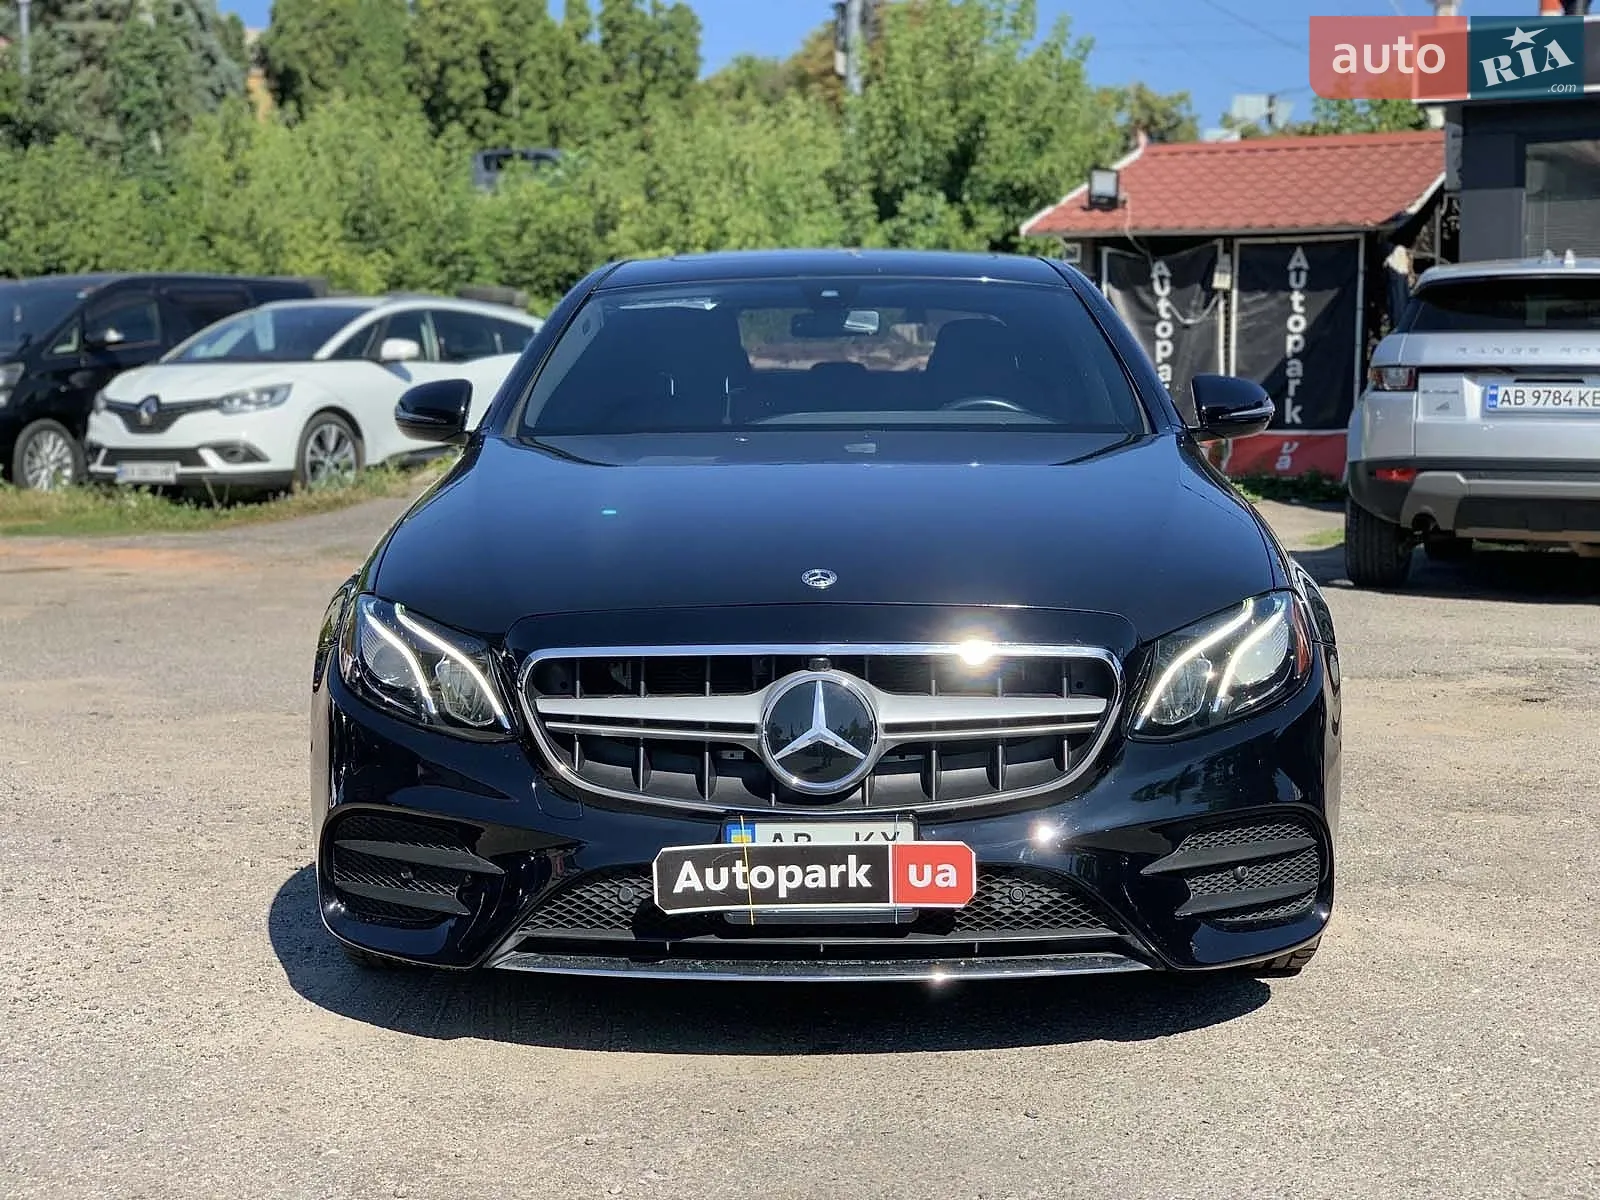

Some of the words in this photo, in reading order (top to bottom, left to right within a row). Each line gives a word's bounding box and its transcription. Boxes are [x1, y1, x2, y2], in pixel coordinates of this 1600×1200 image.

[1284, 246, 1310, 424] Autopark
[1500, 389, 1526, 406] AB
[1531, 389, 1573, 406] 9784
[672, 855, 873, 898] Autopark
[908, 863, 958, 889] ua
